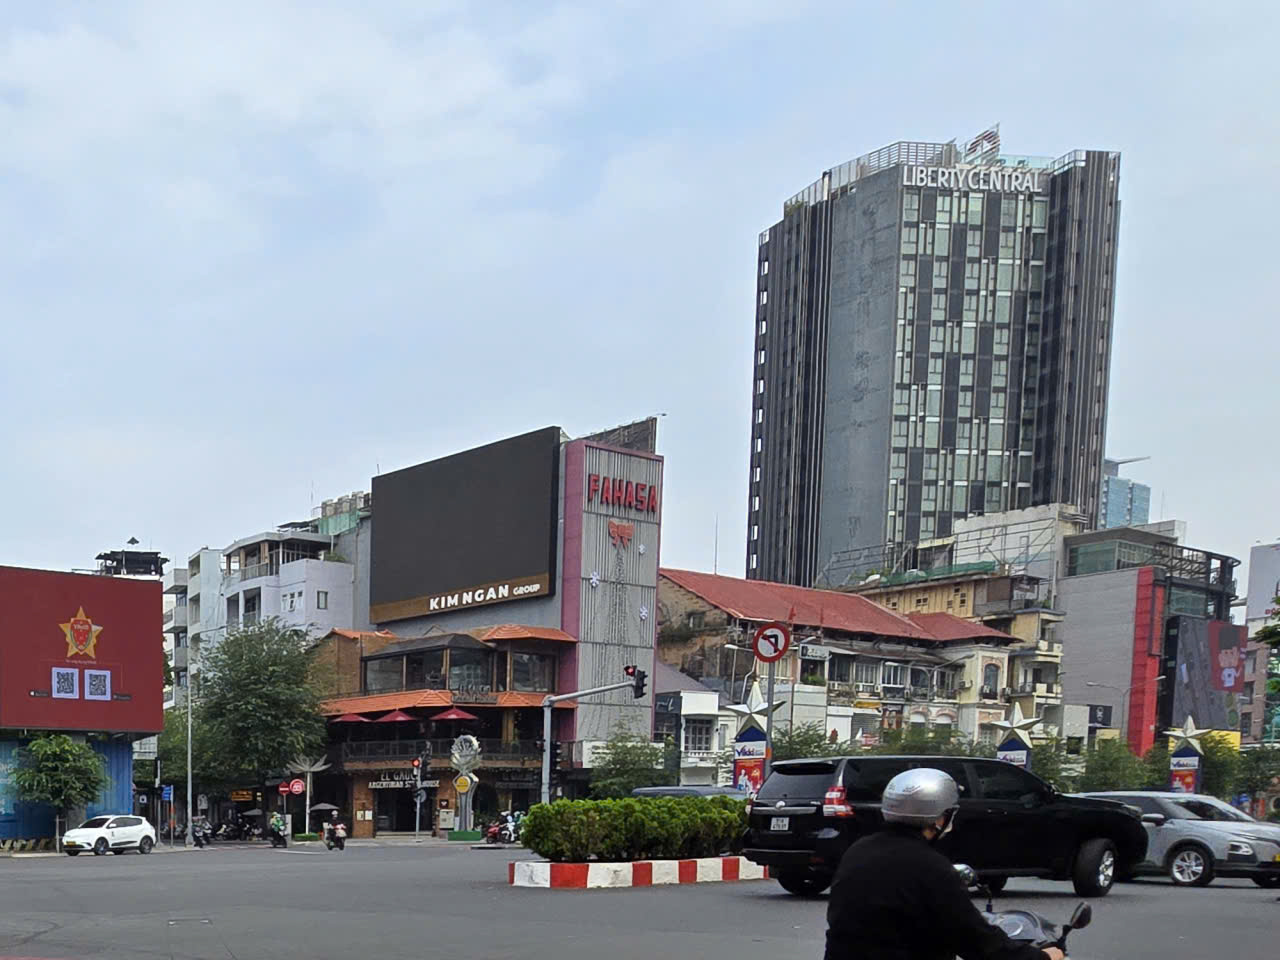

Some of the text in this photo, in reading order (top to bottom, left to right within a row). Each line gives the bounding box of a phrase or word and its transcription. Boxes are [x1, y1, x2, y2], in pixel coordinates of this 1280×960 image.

[902, 165, 1043, 192] LIBERTY CENTRAL
[588, 473, 658, 513] FAHASA
[429, 583, 541, 611] KIM NGAN GROUP
[380, 771, 391, 781] EL
